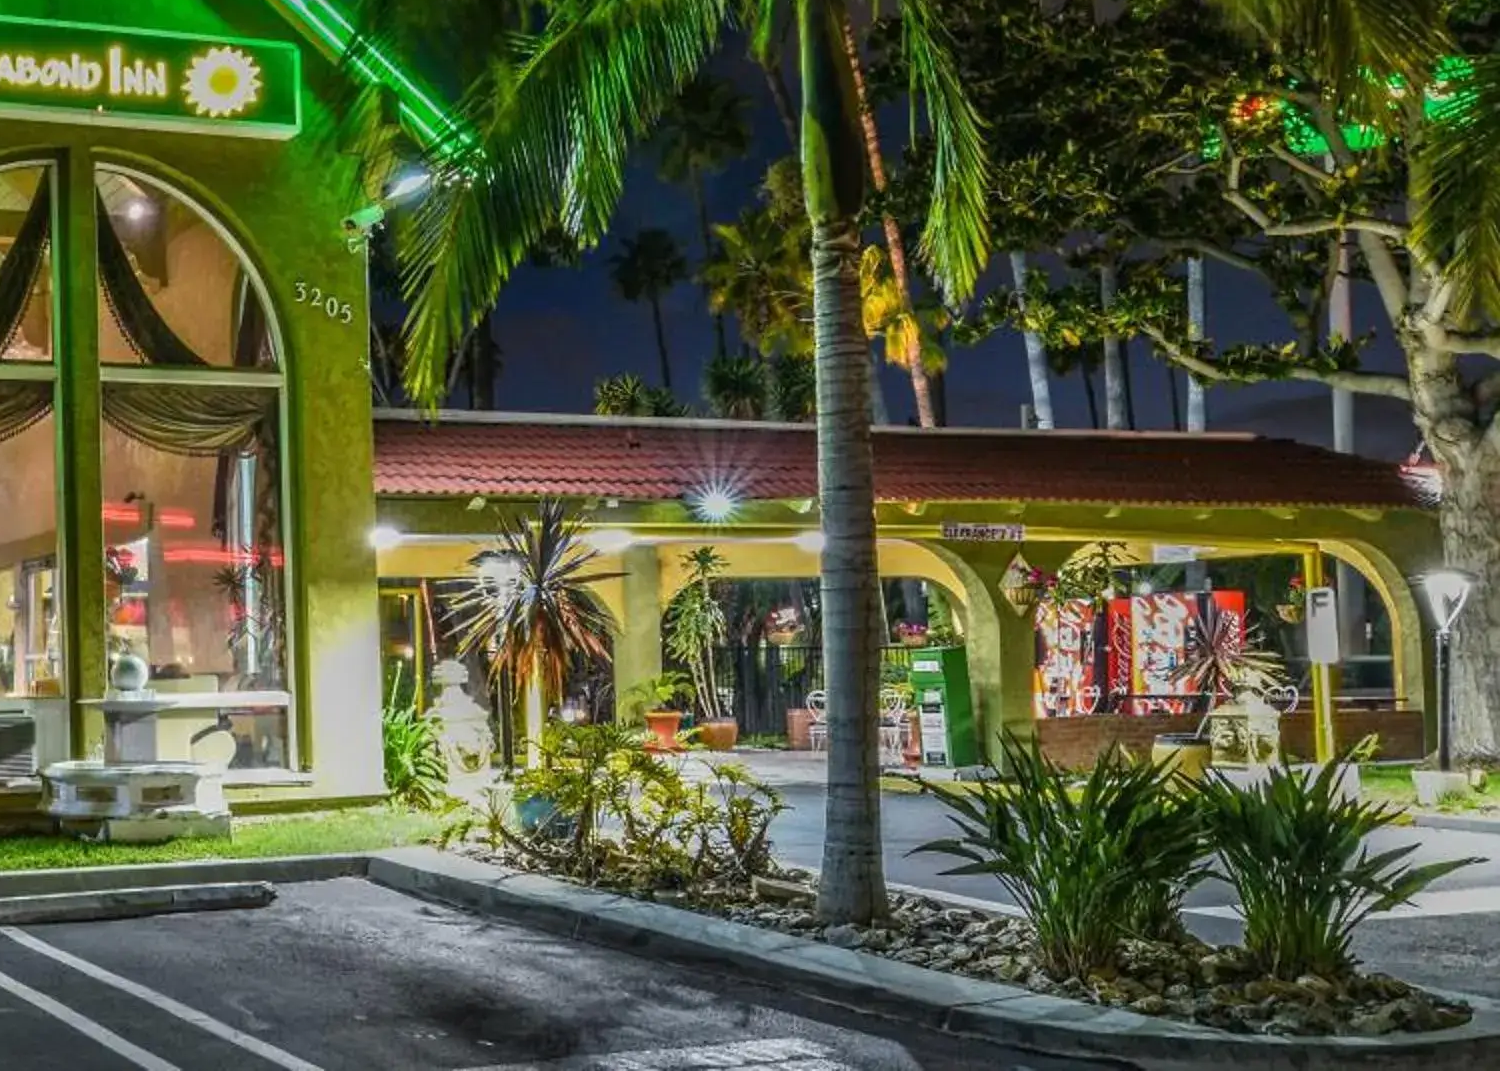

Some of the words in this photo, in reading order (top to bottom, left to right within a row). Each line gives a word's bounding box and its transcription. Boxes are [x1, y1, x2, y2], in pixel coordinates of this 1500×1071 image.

[108, 45, 168, 98] INN
[295, 282, 353, 324] 3205
[1311, 592, 1329, 618] F
